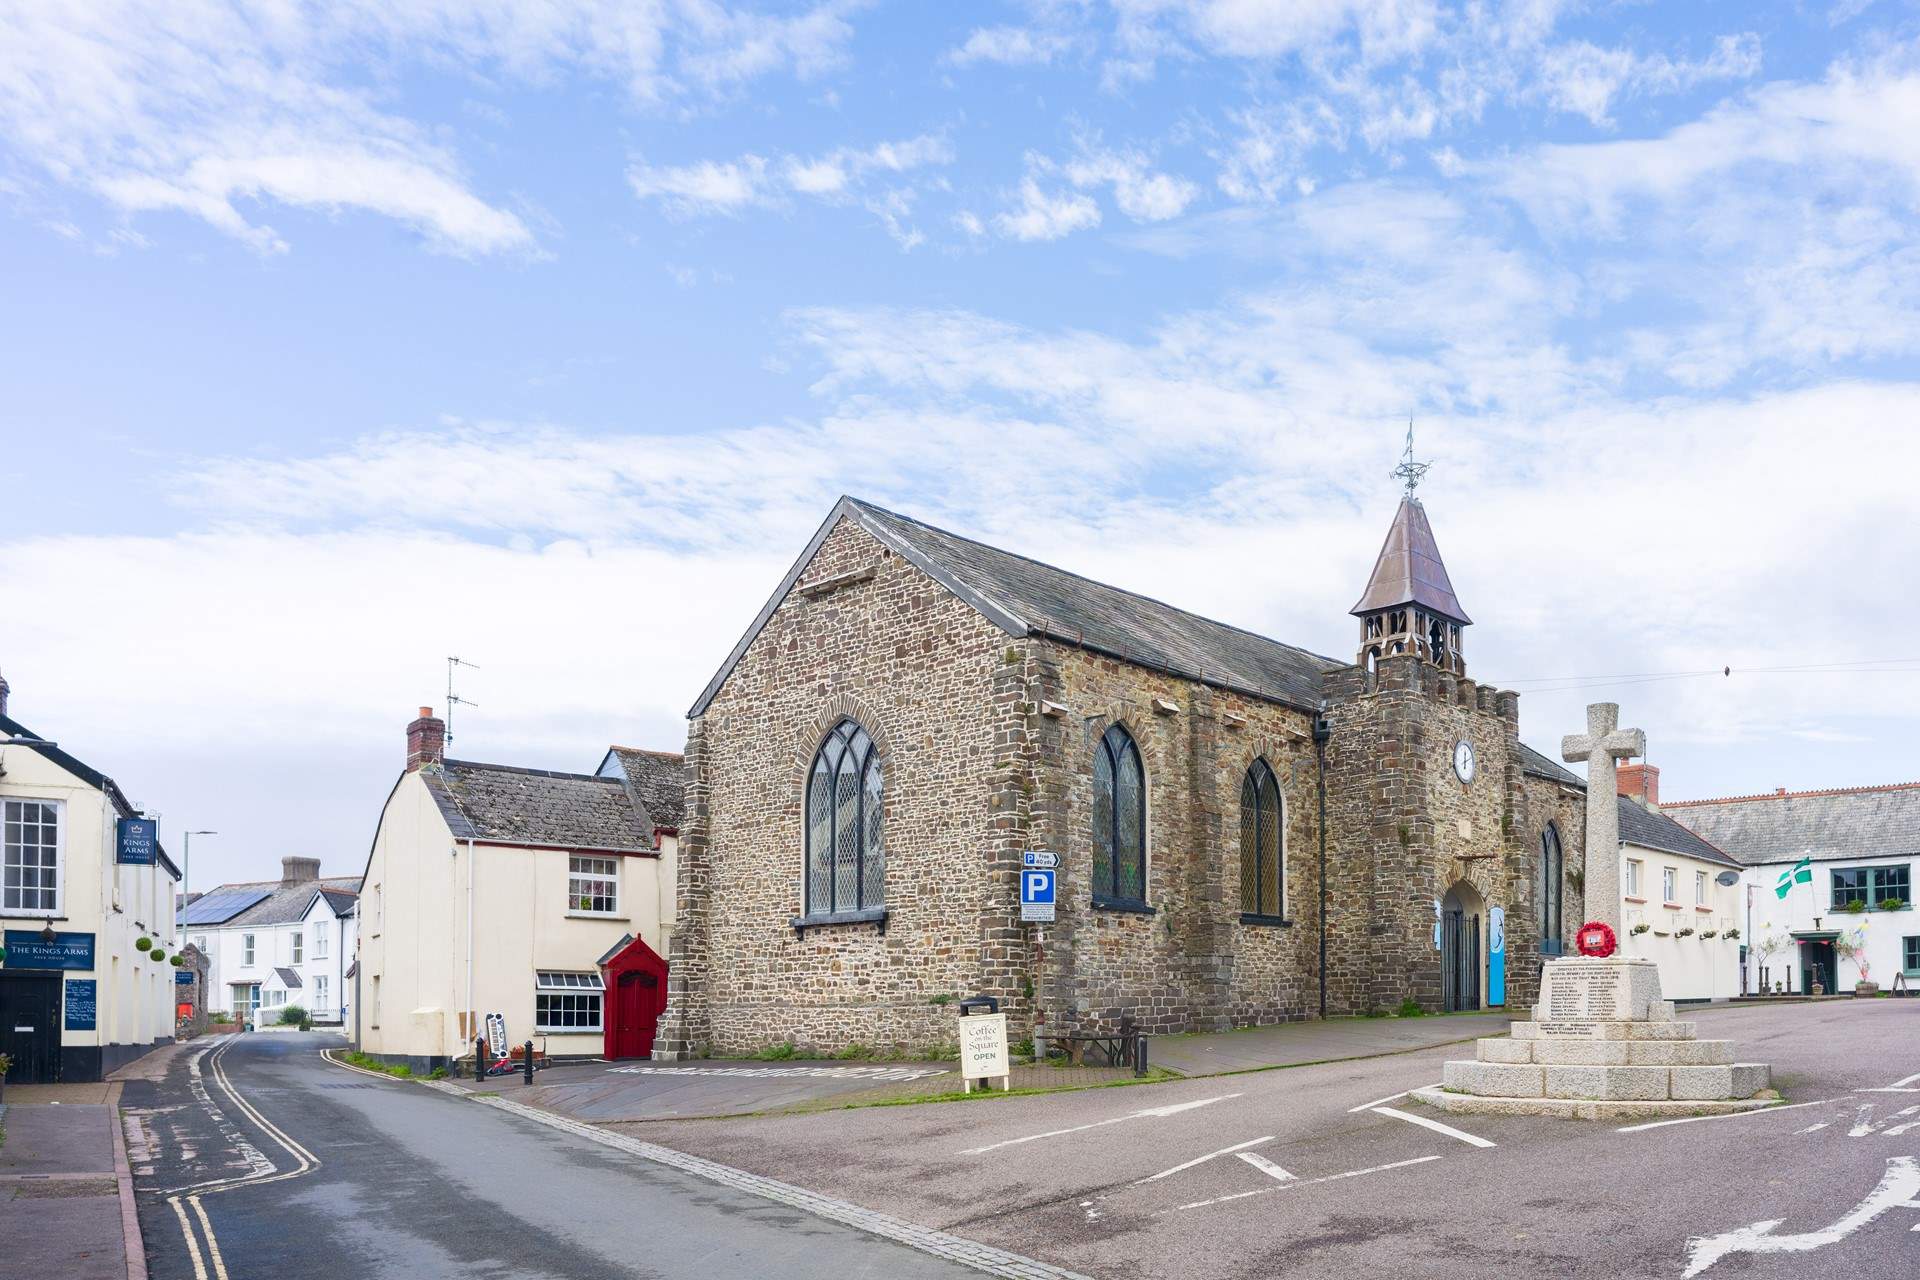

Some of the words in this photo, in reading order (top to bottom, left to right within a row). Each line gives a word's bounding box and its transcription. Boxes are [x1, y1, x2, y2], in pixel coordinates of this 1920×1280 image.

[123, 838, 150, 847] KINGS
[125, 846, 149, 854] ARMS
[1027, 854, 1034, 863] P
[1028, 874, 1048, 901] P
[11, 946, 30, 954] THE
[32, 946, 61, 955] KINGS
[63, 947, 89, 956] ARMS
[968, 1024, 997, 1036] Coffee
[969, 1041, 999, 1052] Square
[974, 1052, 996, 1061] OPEN
